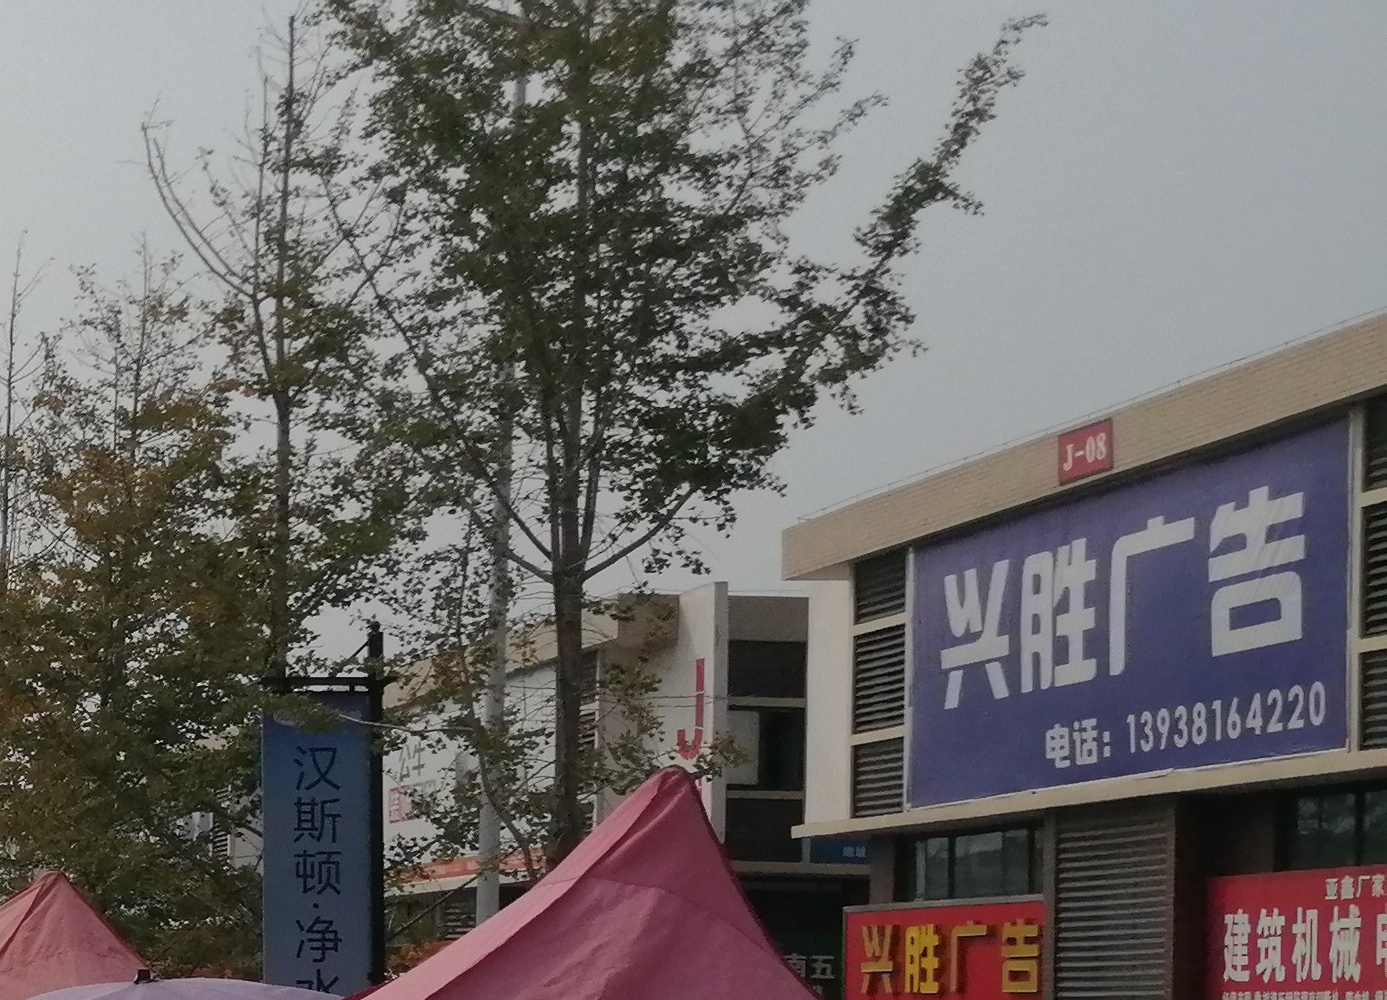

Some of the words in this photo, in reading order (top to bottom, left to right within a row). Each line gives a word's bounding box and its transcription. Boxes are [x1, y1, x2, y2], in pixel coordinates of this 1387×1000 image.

[1063, 431, 1108, 472] J-08
[940, 486, 1306, 710] 兴胜广告
[860, 918, 1040, 994] 兴胜广告
